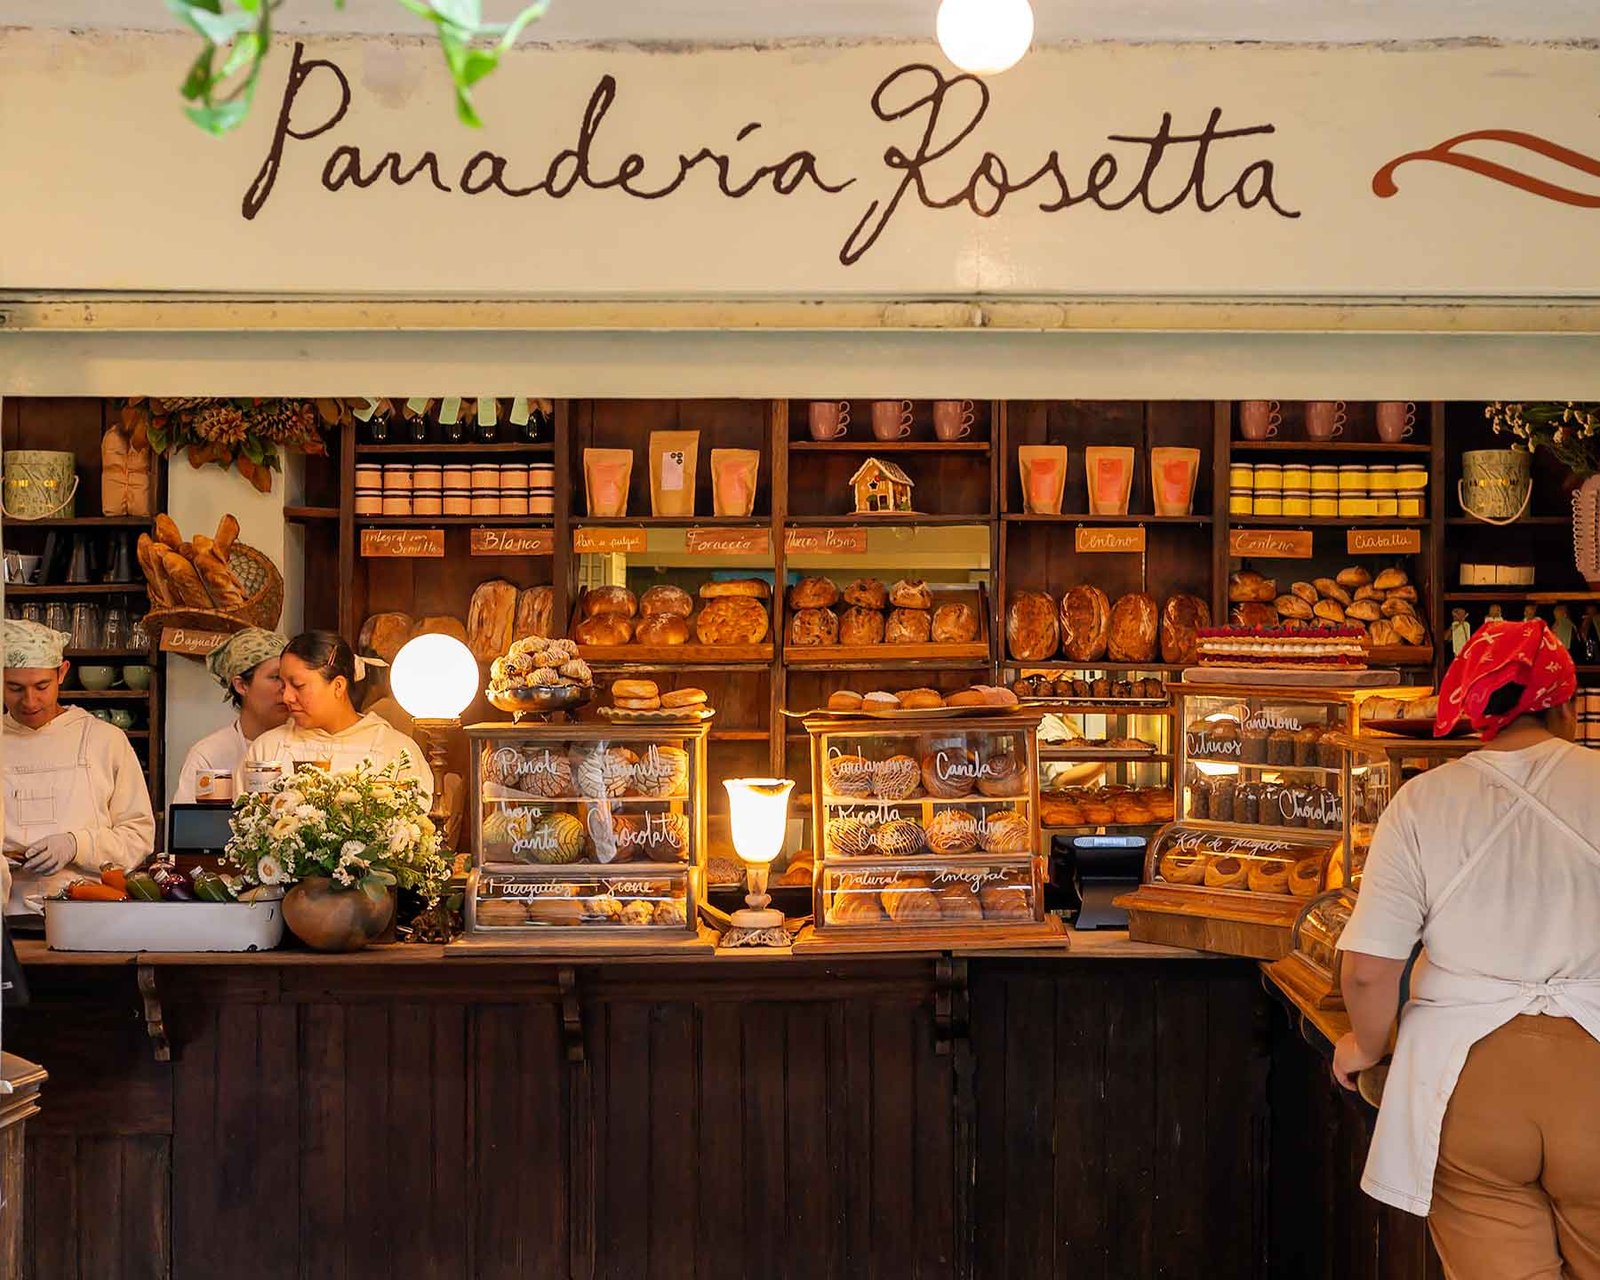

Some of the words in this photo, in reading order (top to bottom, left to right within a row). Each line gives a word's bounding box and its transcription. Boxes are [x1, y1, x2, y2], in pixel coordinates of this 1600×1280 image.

[241, 41, 857, 221] Panadería
[839, 63, 1301, 265] Rosetta
[483, 531, 542, 551] Blanco
[1079, 529, 1139, 550] Centeno
[494, 747, 562, 777] Pinole
[936, 750, 999, 781] Canela
[507, 823, 559, 854] Santa
[833, 869, 902, 886] Natural
